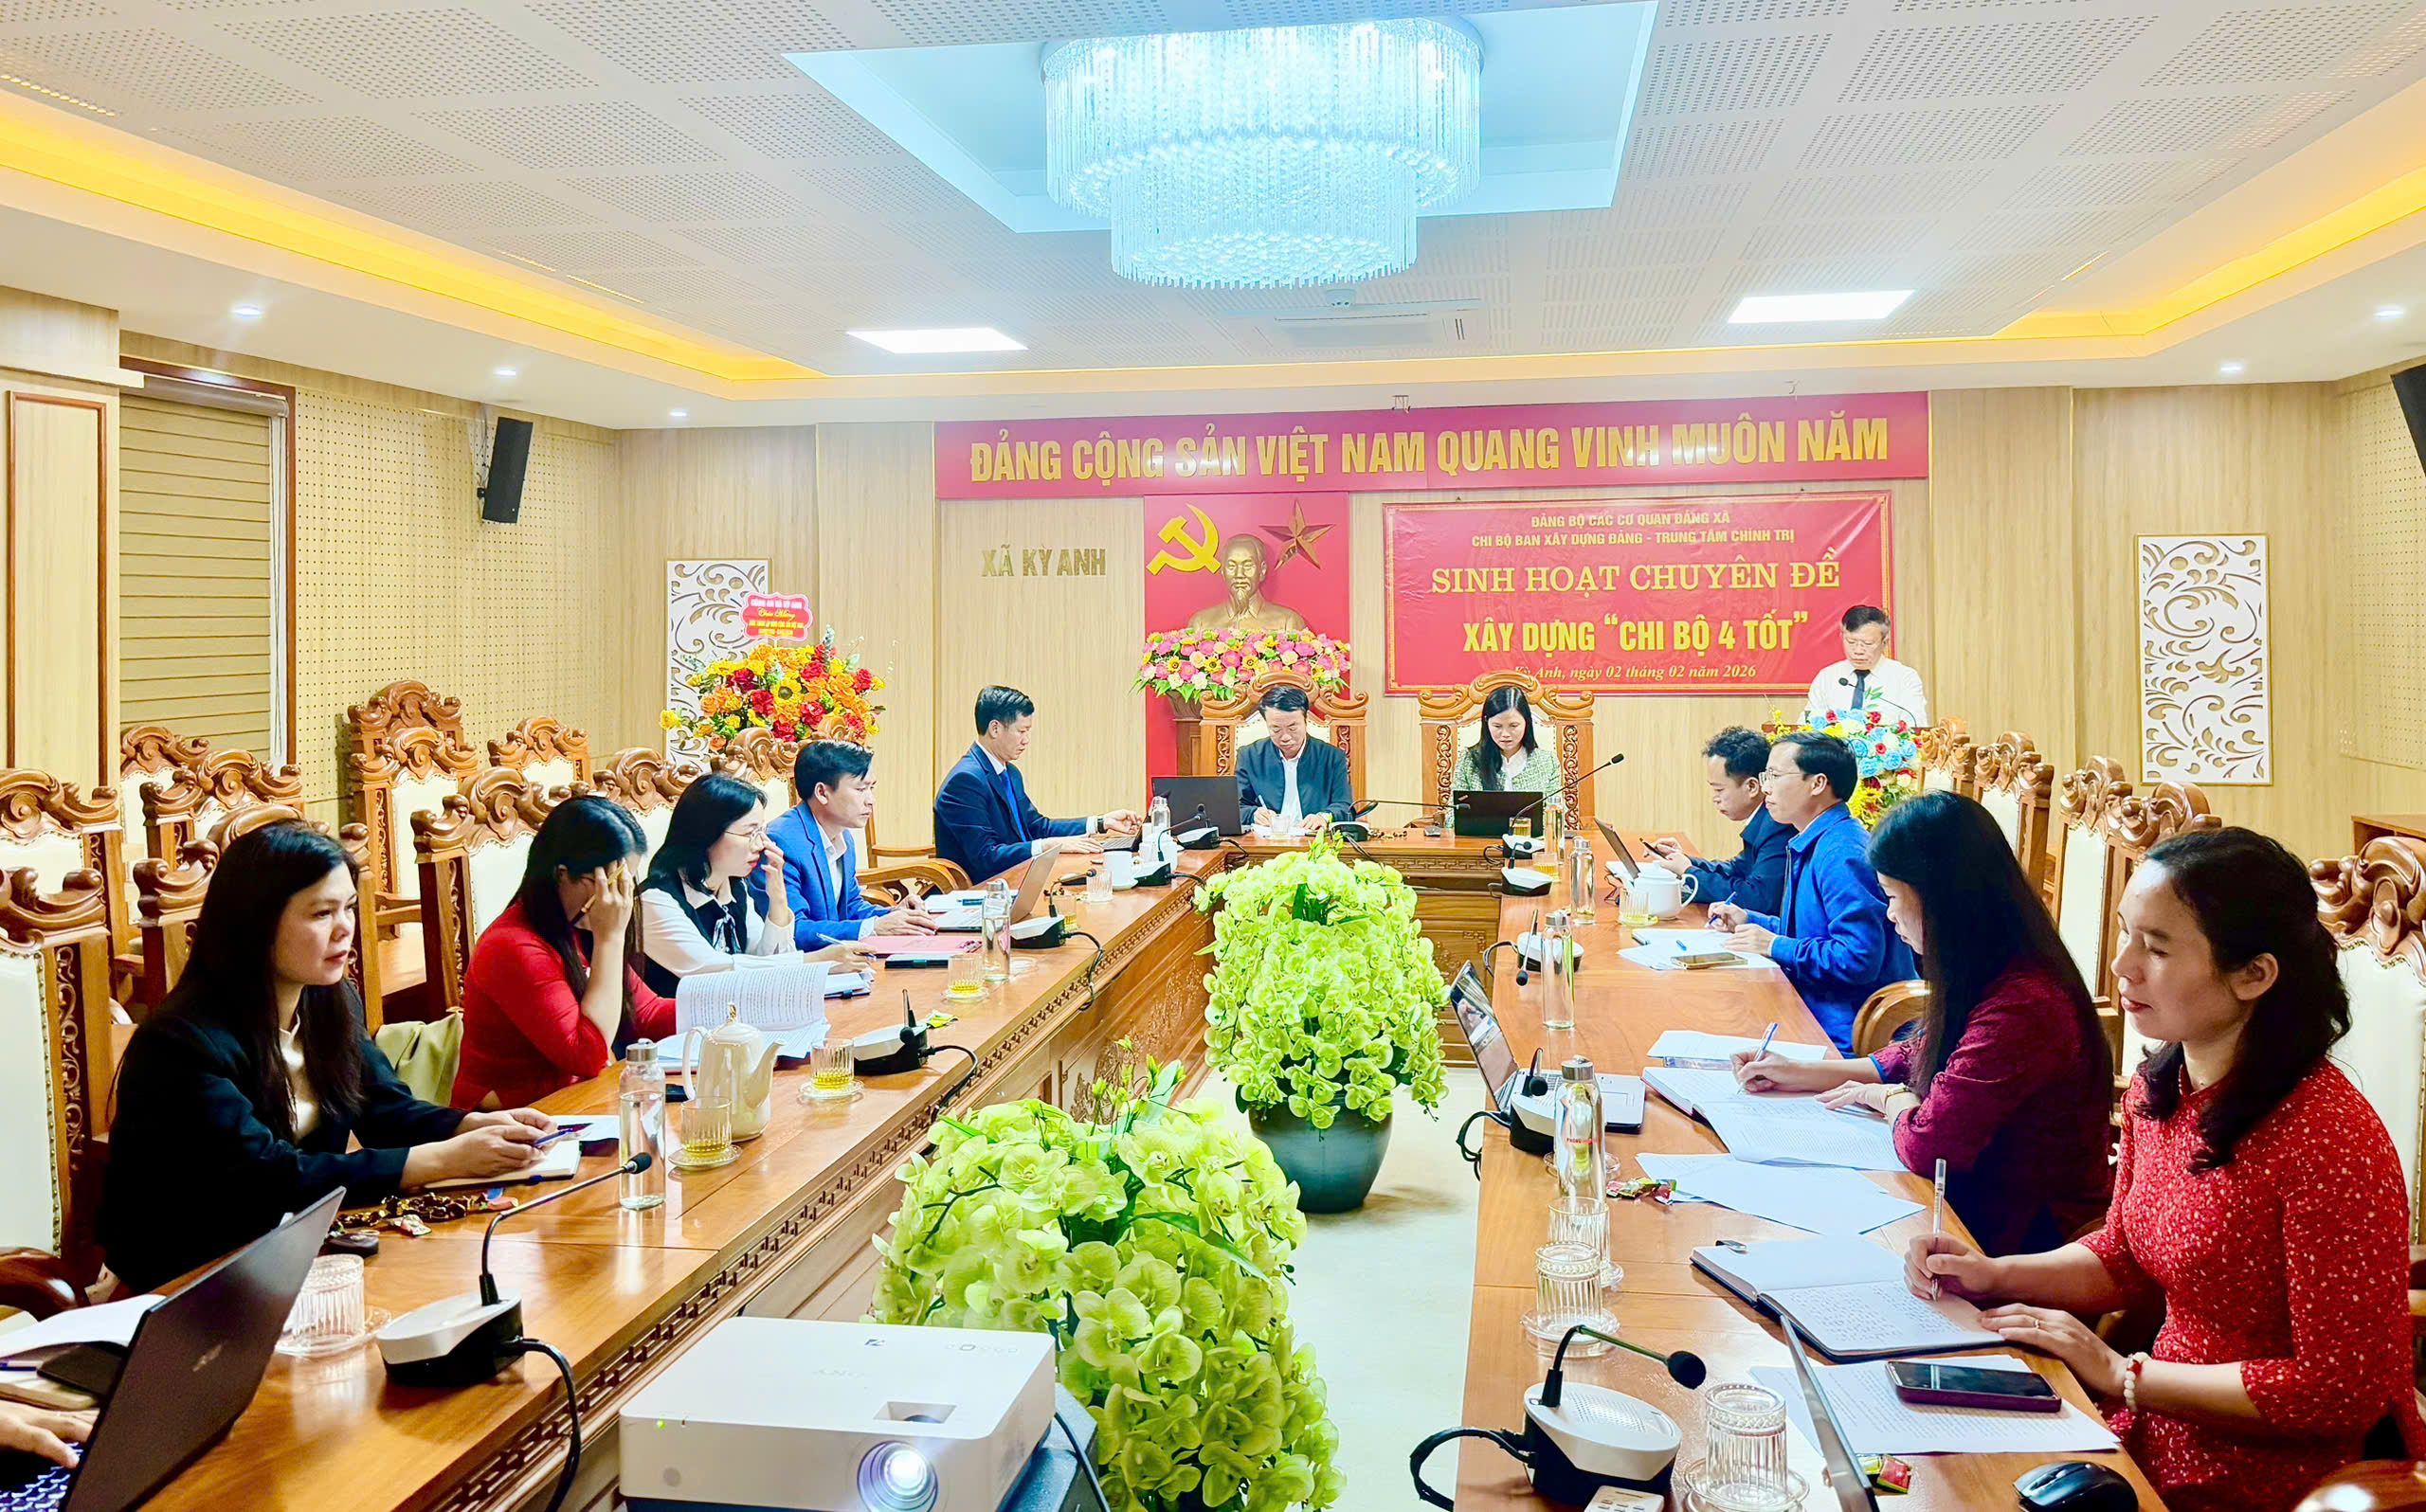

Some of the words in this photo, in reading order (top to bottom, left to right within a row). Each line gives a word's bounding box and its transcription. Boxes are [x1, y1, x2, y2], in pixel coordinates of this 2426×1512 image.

[970, 427, 1061, 482] ĐẢNG
[1072, 430, 1165, 486] CỘNG
[1174, 423, 1246, 477] SẢN
[1256, 425, 1329, 482] VIỆT
[1341, 431, 1425, 474] NAM
[1437, 427, 1559, 477] QUANG
[1571, 424, 1659, 469] VINH
[1672, 412, 1785, 465] MUÔN
[1797, 410, 1889, 462] NĂM
[1568, 513, 1584, 529] BỘ
[1638, 513, 1671, 526] QUAN
[1472, 535, 1493, 547] CHI
[1495, 532, 1512, 548] BỘ
[1515, 534, 1541, 547] BAN
[1544, 531, 1568, 547] XÂY
[1656, 531, 1696, 544] TRUNG
[1700, 529, 1728, 543] TÂM
[1774, 530, 1795, 543] TRỊ
[982, 544, 1015, 577] XÃ
[1056, 548, 1107, 576] ANH
[1432, 567, 1515, 594] SINH
[1524, 566, 1620, 598] HOẠT
[1629, 554, 1780, 590] CHUYÊN
[1789, 547, 1840, 588] ĐỀ
[1462, 617, 1514, 652] XÂY
[1522, 620, 1596, 657] DỰNG
[1603, 613, 1664, 651] “CHI
[1674, 614, 1711, 657] BỘ
[1718, 621, 1736, 651] 4
[1743, 609, 1809, 651] TỐT”
[1535, 667, 1566, 680] Anh,
[1569, 666, 1602, 680] ngày
[1605, 666, 1622, 678] 02
[1625, 665, 1665, 680] tháng
[1668, 665, 1685, 677] 02
[1689, 665, 1719, 677] năm
[1724, 665, 1756, 678] 2026
